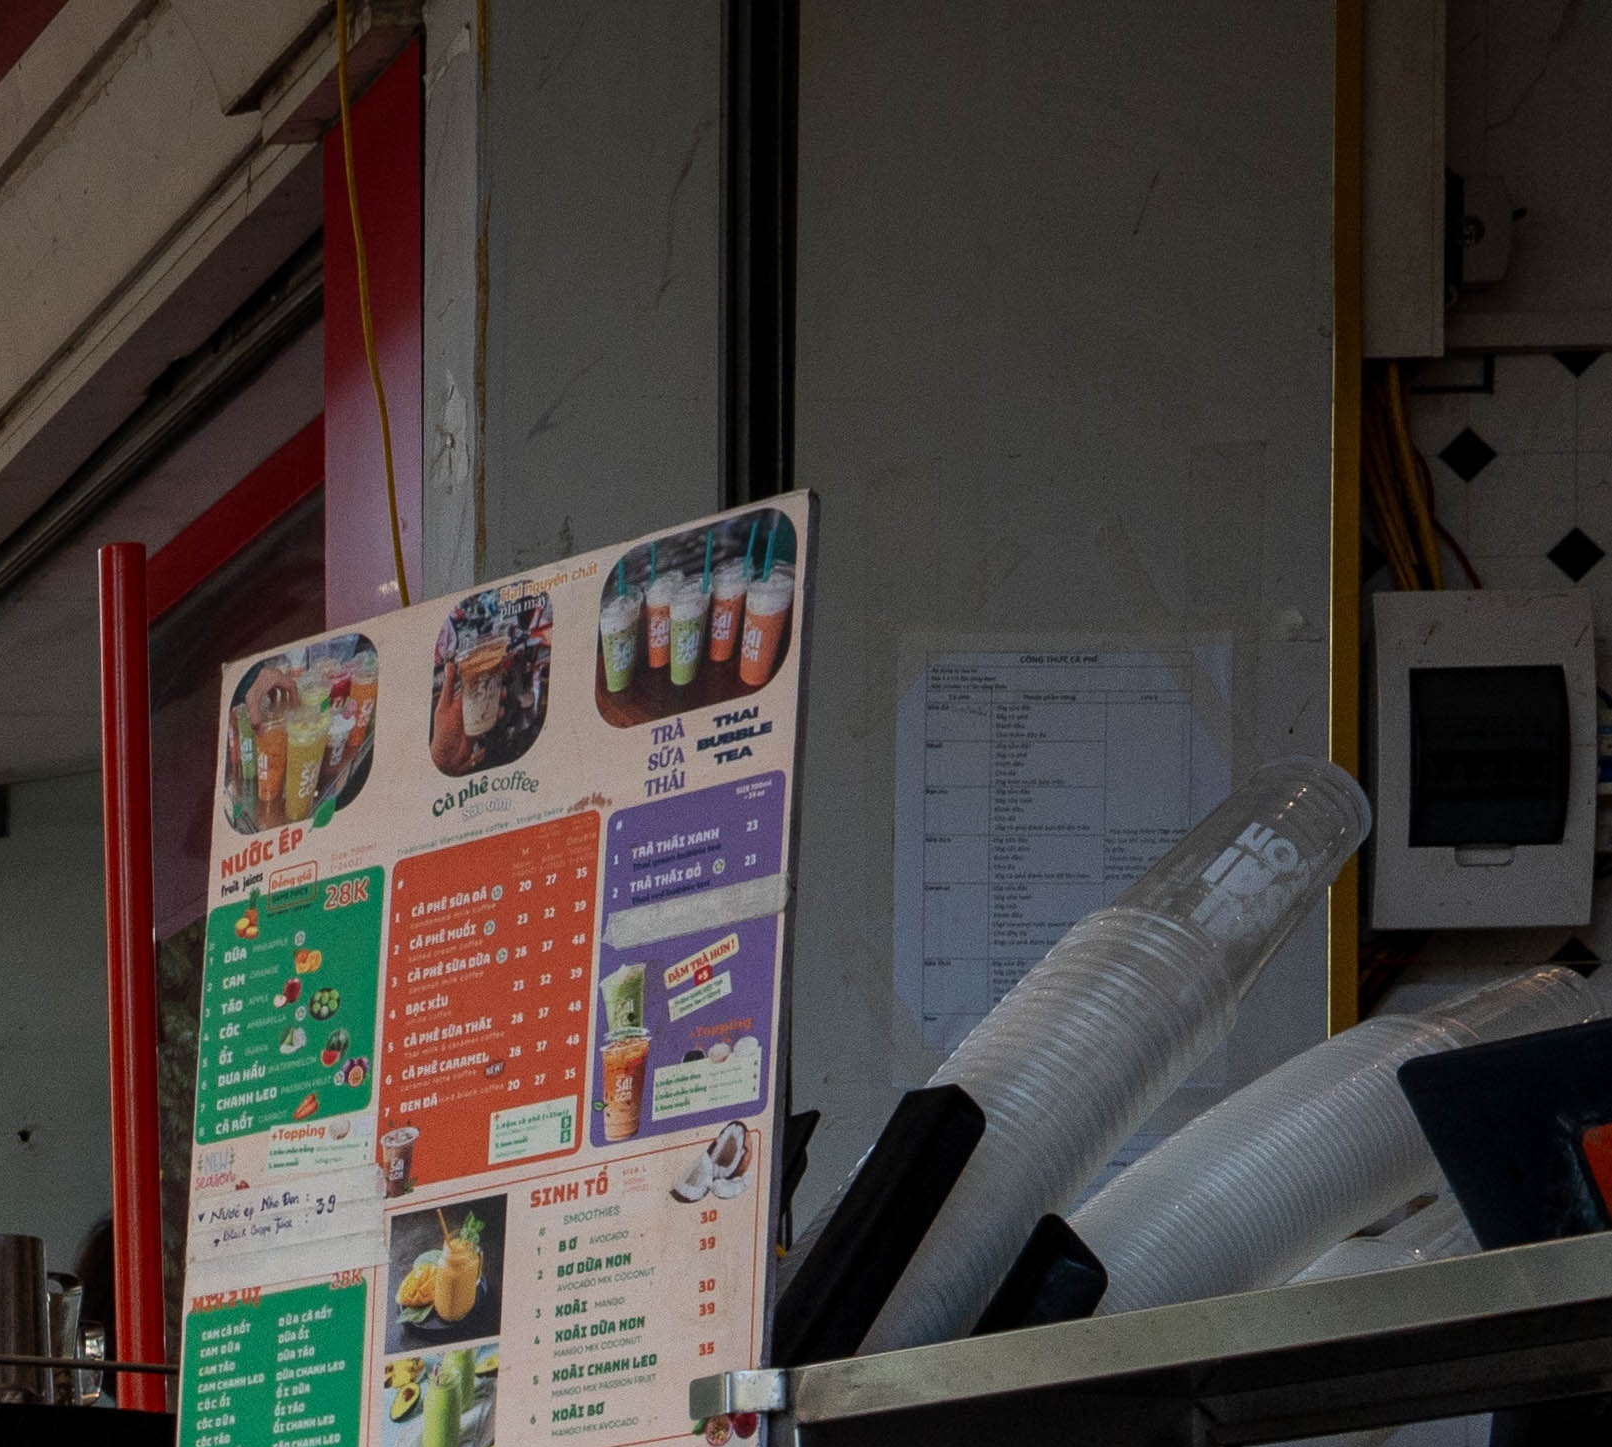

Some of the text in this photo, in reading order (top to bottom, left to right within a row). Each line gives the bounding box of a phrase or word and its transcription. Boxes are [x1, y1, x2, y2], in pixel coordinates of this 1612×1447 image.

[651, 706, 759, 745] TRÀ THAI
[647, 721, 773, 771] SỮA BUBBLE
[644, 746, 753, 797] THÁI TEA
[432, 771, 539, 817] Cà phê coffee
[221, 827, 303, 878] NƯỚC ÉP
[631, 820, 759, 859] TRÀ THÁI XANH 23
[412, 903, 425, 917] CÀ
[427, 896, 447, 914] PHÊ
[519, 880, 532, 892] 20
[545, 874, 557, 885] 27
[576, 867, 587, 879] 35
[630, 876, 651, 893] TRÀ
[654, 869, 683, 886] THÁI
[744, 854, 756, 866] 23
[324, 876, 369, 911] 28K
[409, 900, 587, 950] CÀ PHÊ MUỐI 23 32 39
[222, 974, 246, 990] CAM
[222, 1000, 243, 1015] TÁO
[406, 1002, 426, 1018] BẠC
[440, 1052, 489, 1071] CARAMEL
[217, 1086, 277, 1111] CHANH LEO
[530, 1165, 608, 1208] SINH TỐ
[559, 1210, 717, 1252] BƠ AVOCADO 30
[563, 1205, 620, 1225] SMOOTHIES
[557, 1262, 575, 1277] BƠ
[605, 1253, 632, 1267] NON
[699, 1237, 716, 1251] 39
[555, 1279, 716, 1318] XOÀI MANGO 30
[555, 1325, 587, 1343] XOÀI
[619, 1316, 645, 1331] NON
[699, 1302, 716, 1317] 39
[552, 1342, 715, 1383] XOÀI CHANH LEO 35
[552, 1401, 605, 1422] XOÀI BƠ
